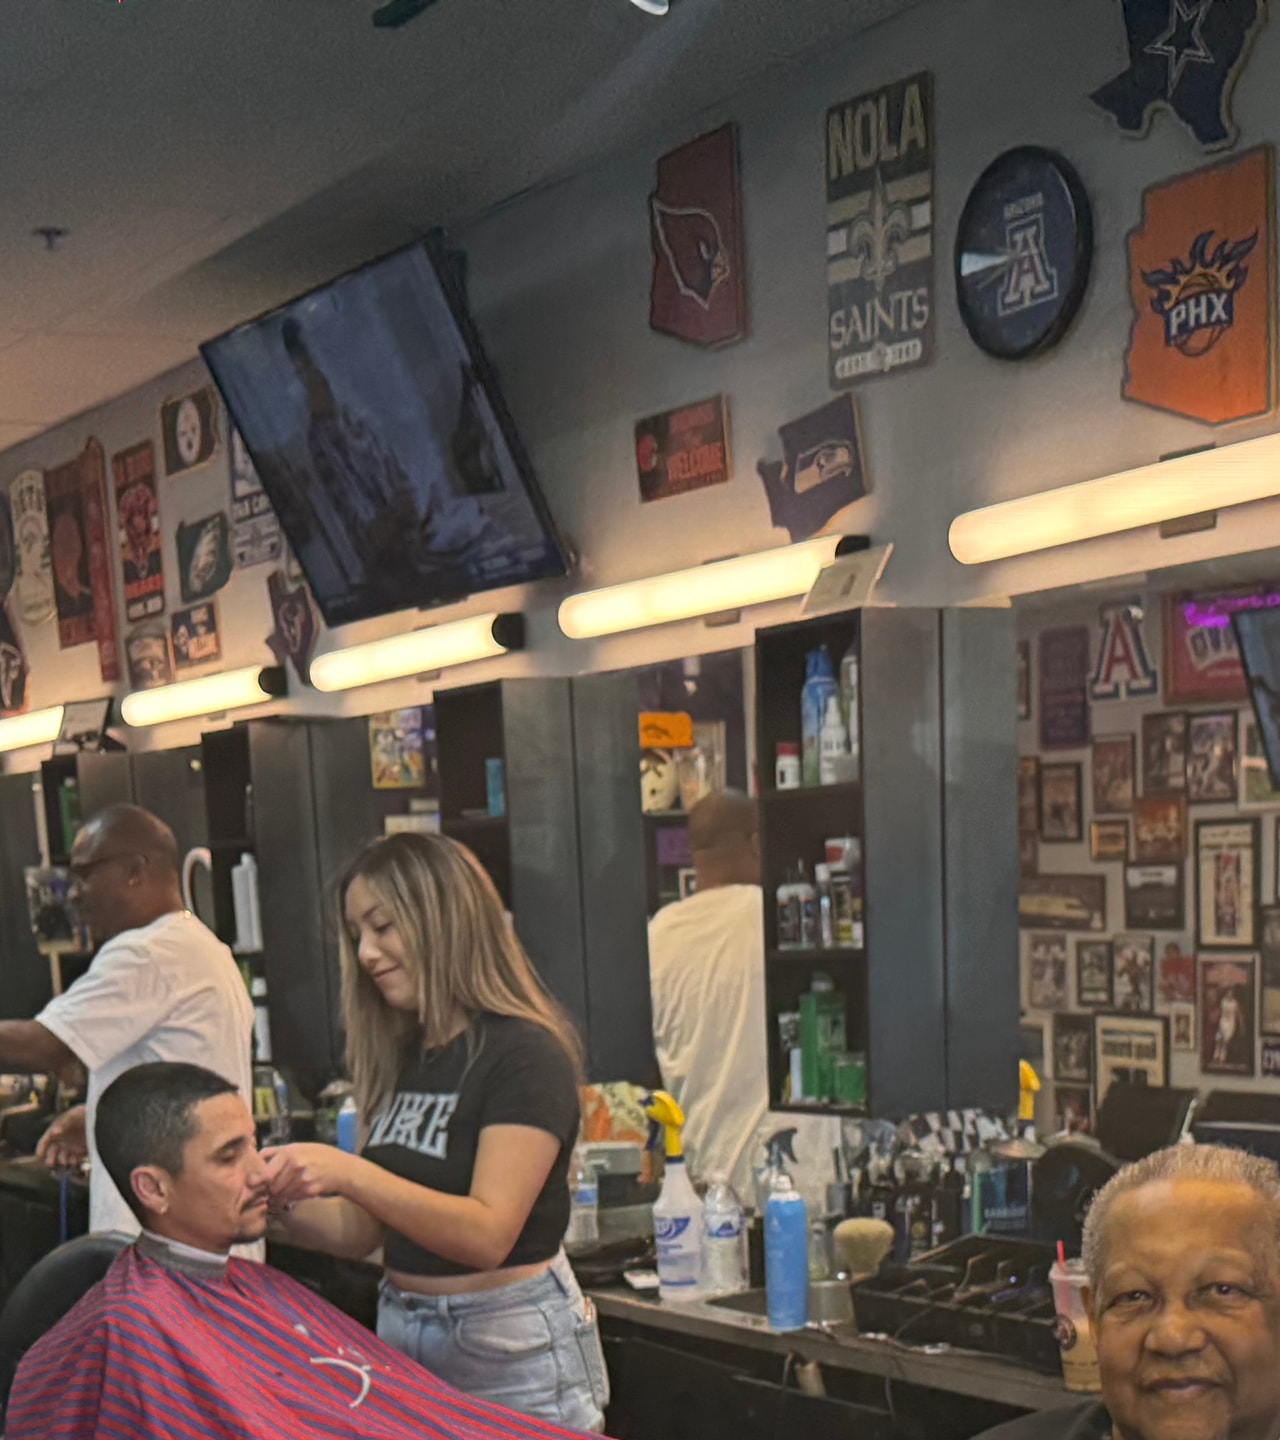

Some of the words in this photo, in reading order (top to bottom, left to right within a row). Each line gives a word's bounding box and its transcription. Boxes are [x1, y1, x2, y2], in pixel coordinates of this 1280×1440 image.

[828, 83, 927, 181] NOLA
[830, 287, 929, 350] SAINTS
[1170, 293, 1229, 336] PHX
